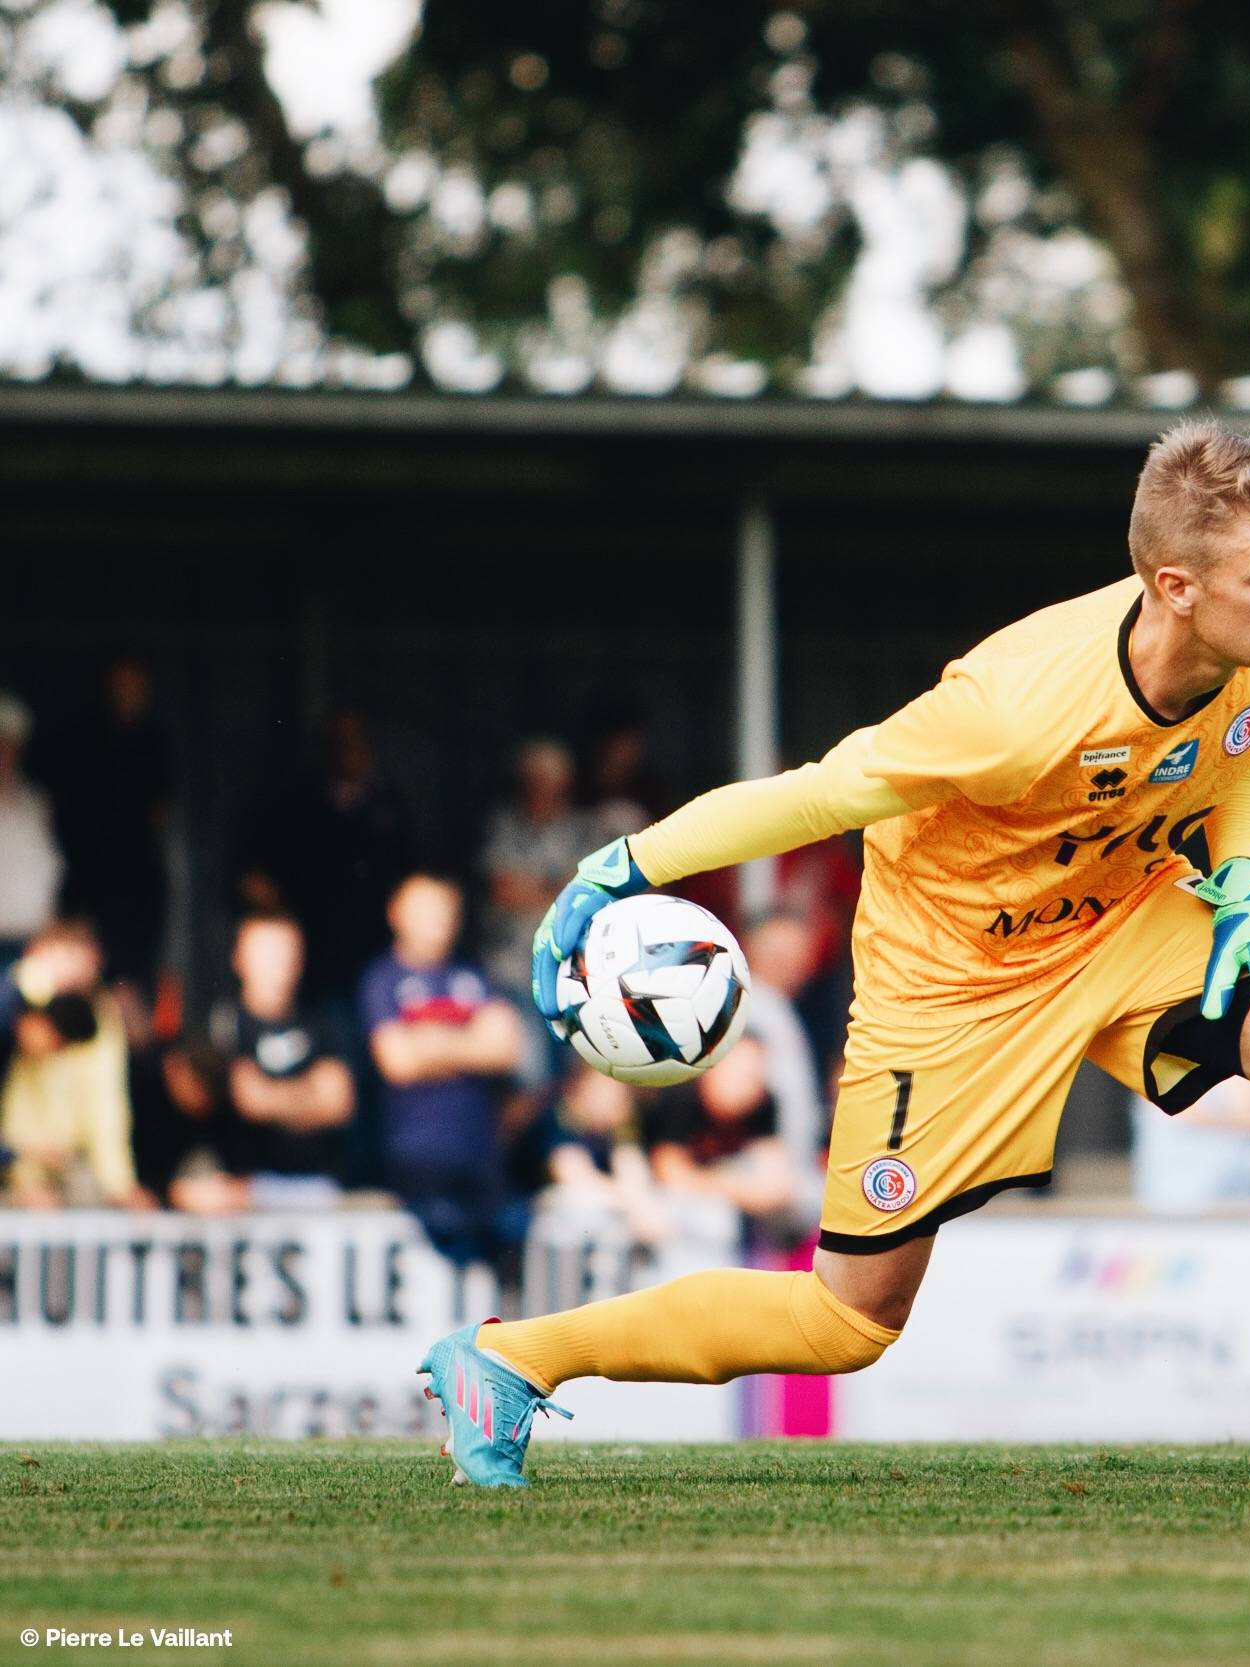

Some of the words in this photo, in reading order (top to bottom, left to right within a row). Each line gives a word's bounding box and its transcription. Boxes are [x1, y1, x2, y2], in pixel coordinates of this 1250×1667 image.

[1083, 751, 1127, 764] bpifrance
[1154, 763, 1191, 777] INDRE
[888, 1069, 914, 1151] 1
[345, 1242, 406, 1325] LE
